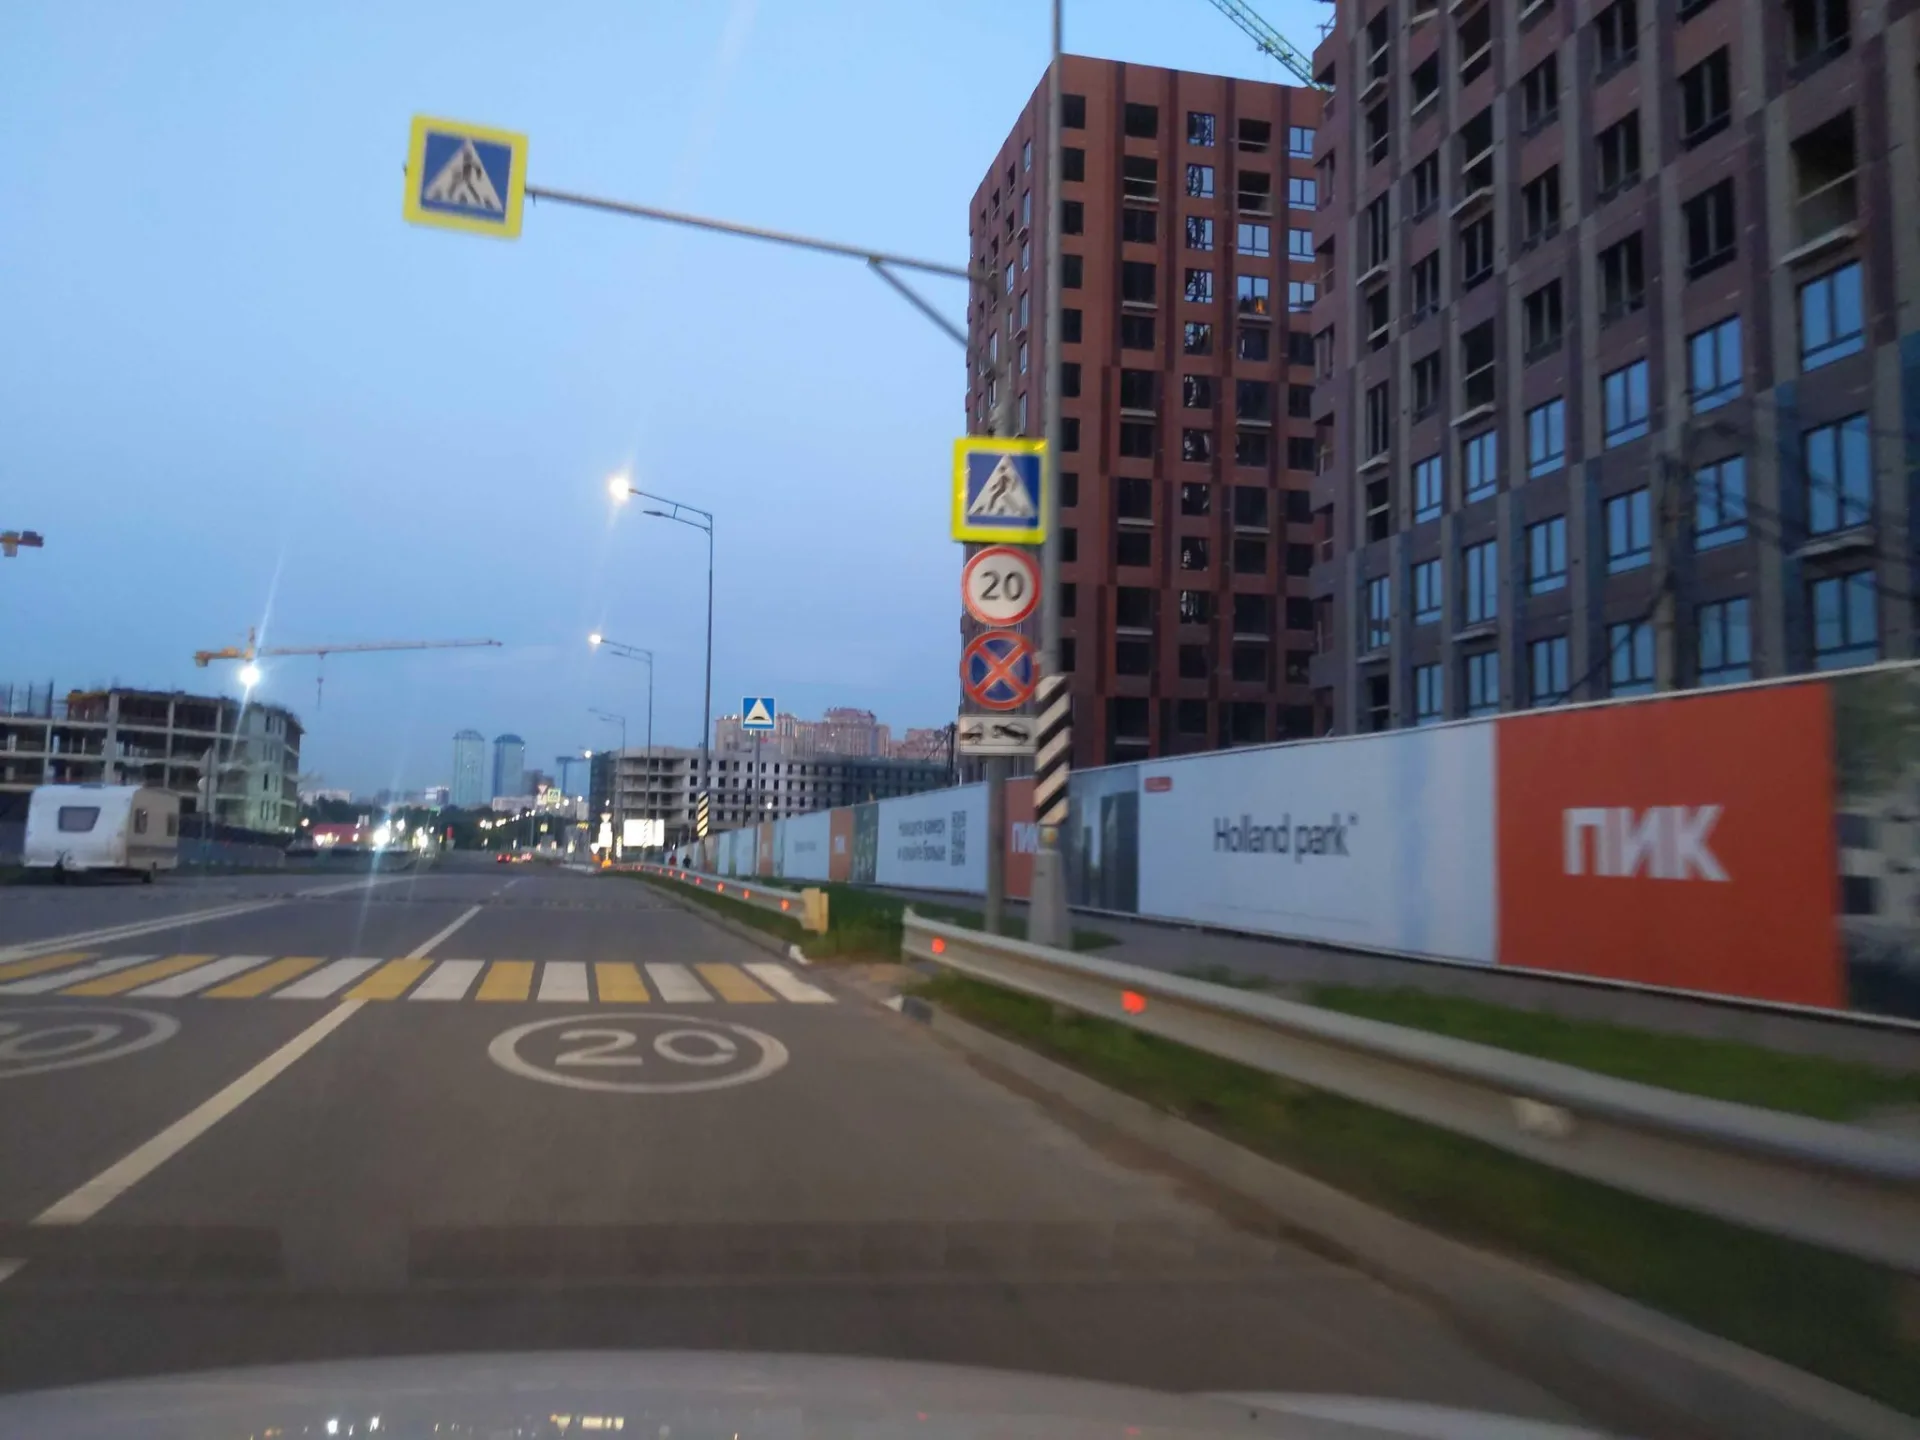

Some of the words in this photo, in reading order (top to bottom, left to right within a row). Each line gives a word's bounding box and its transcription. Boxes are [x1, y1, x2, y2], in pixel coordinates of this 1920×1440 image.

[980, 569, 1024, 602] 20
[1213, 812, 1291, 854] Holland
[1561, 804, 1732, 882] ПИК
[555, 1028, 737, 1066] 20
